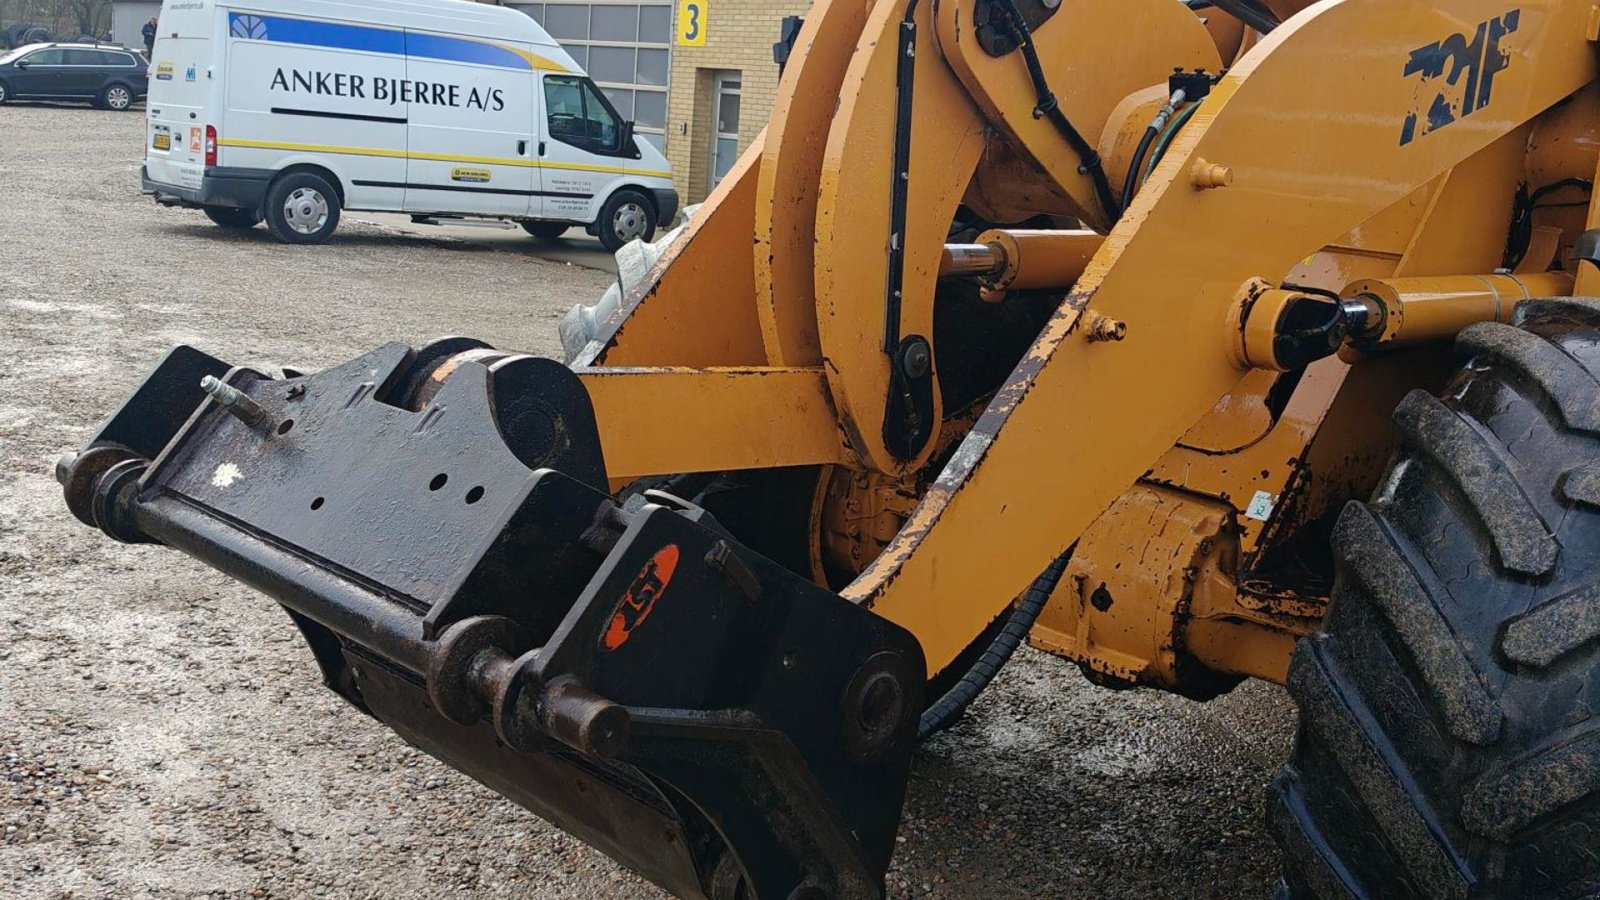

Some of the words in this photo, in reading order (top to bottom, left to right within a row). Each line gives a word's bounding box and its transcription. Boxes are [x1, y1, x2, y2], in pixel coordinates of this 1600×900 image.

[685, 4, 699, 41] 3
[270, 67, 365, 98] ANKER
[373, 77, 460, 106] BJERRE
[466, 86, 505, 112] A/S
